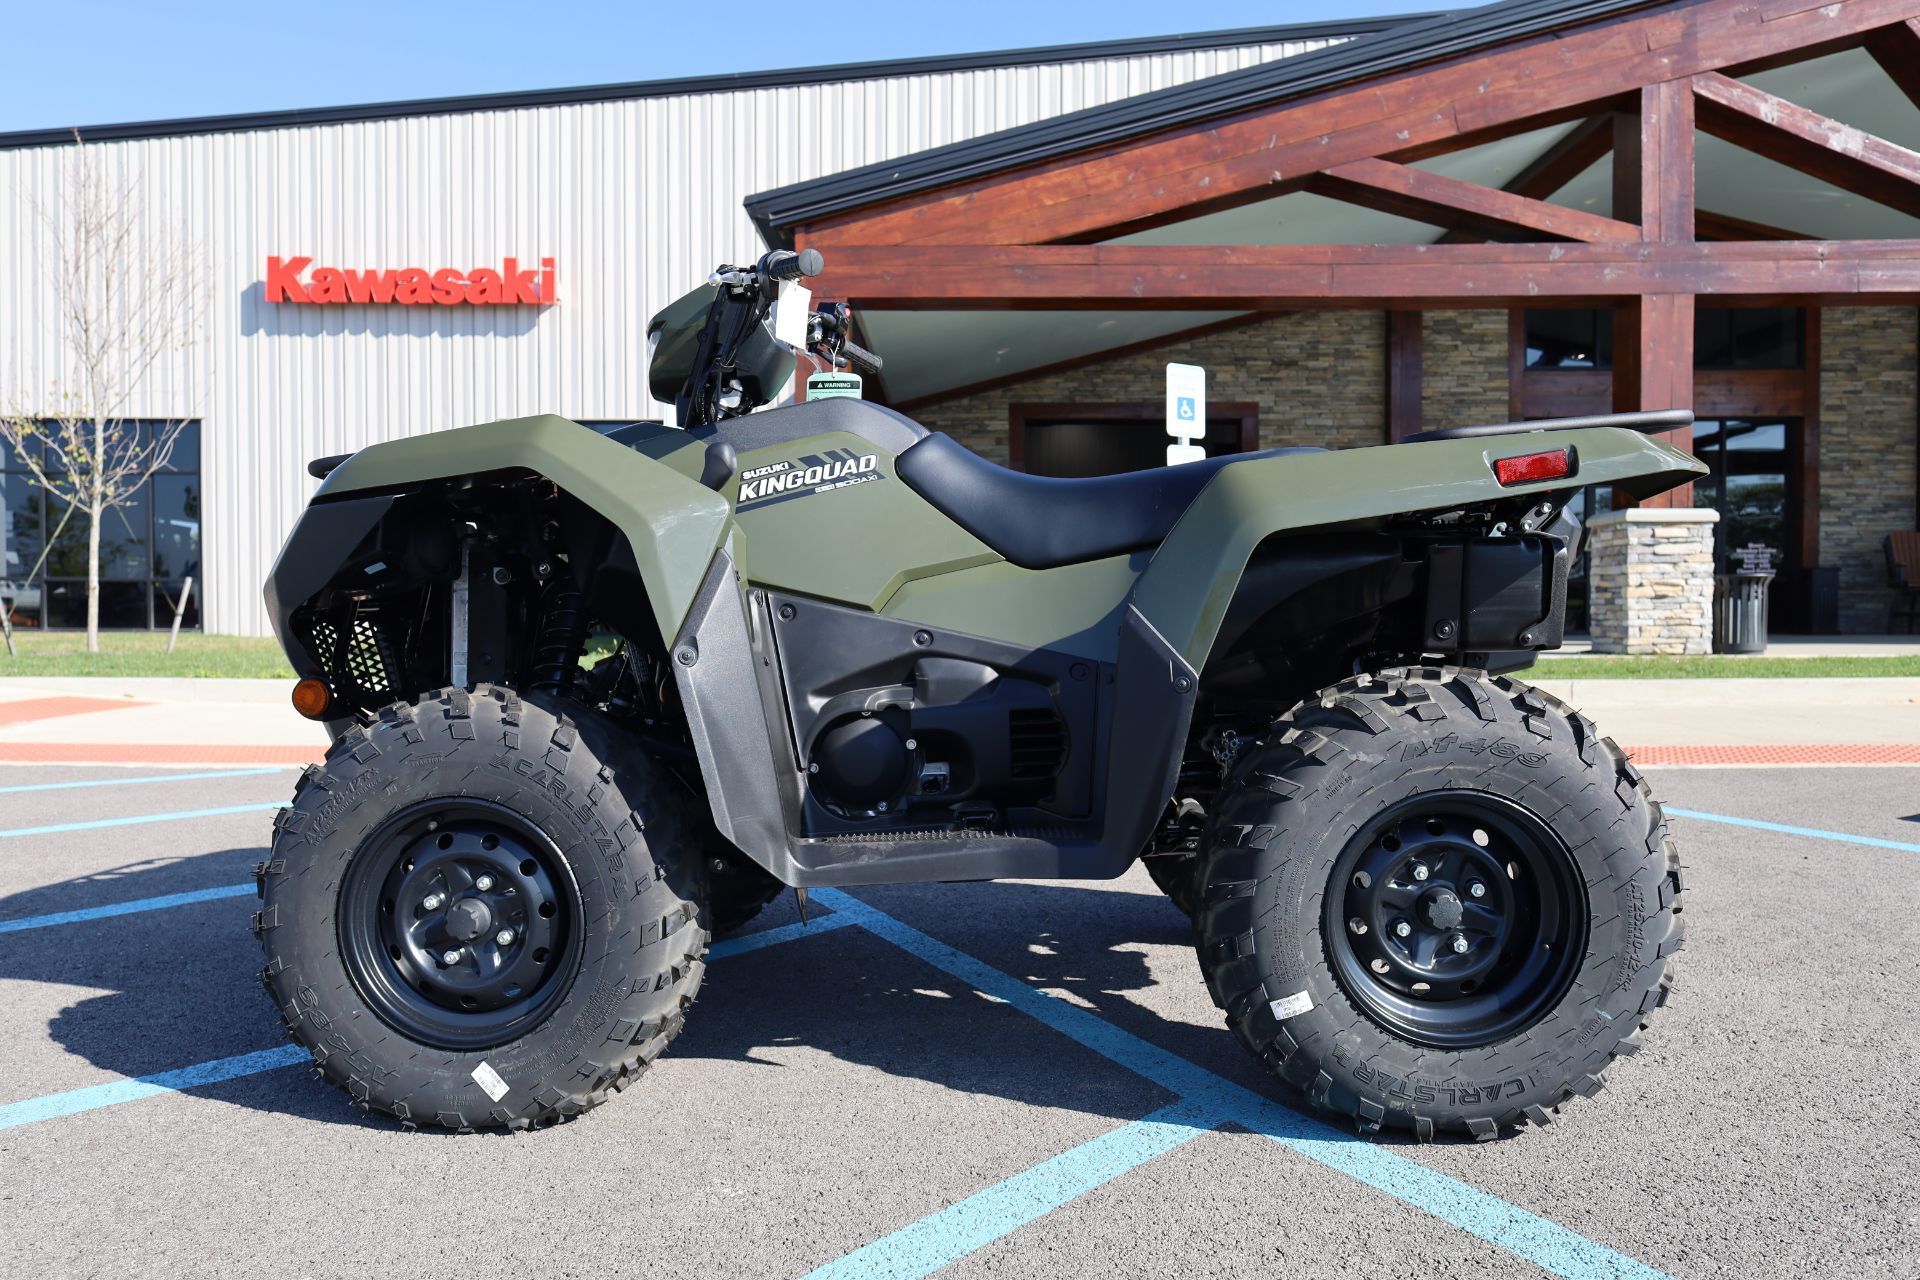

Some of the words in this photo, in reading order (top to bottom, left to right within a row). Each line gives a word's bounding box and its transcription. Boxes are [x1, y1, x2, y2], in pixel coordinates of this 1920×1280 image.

[265, 256, 556, 305] Kawasaki
[739, 454, 878, 502] KINGQUAD
[742, 461, 790, 480] SUZUKI
[1400, 735, 1548, 769] AT489
[514, 758, 625, 874] CARLSTAR
[1627, 881, 1646, 972] AT25x10-12
[297, 984, 400, 1087] AT489
[1352, 1059, 1526, 1106] CARLSTAR
